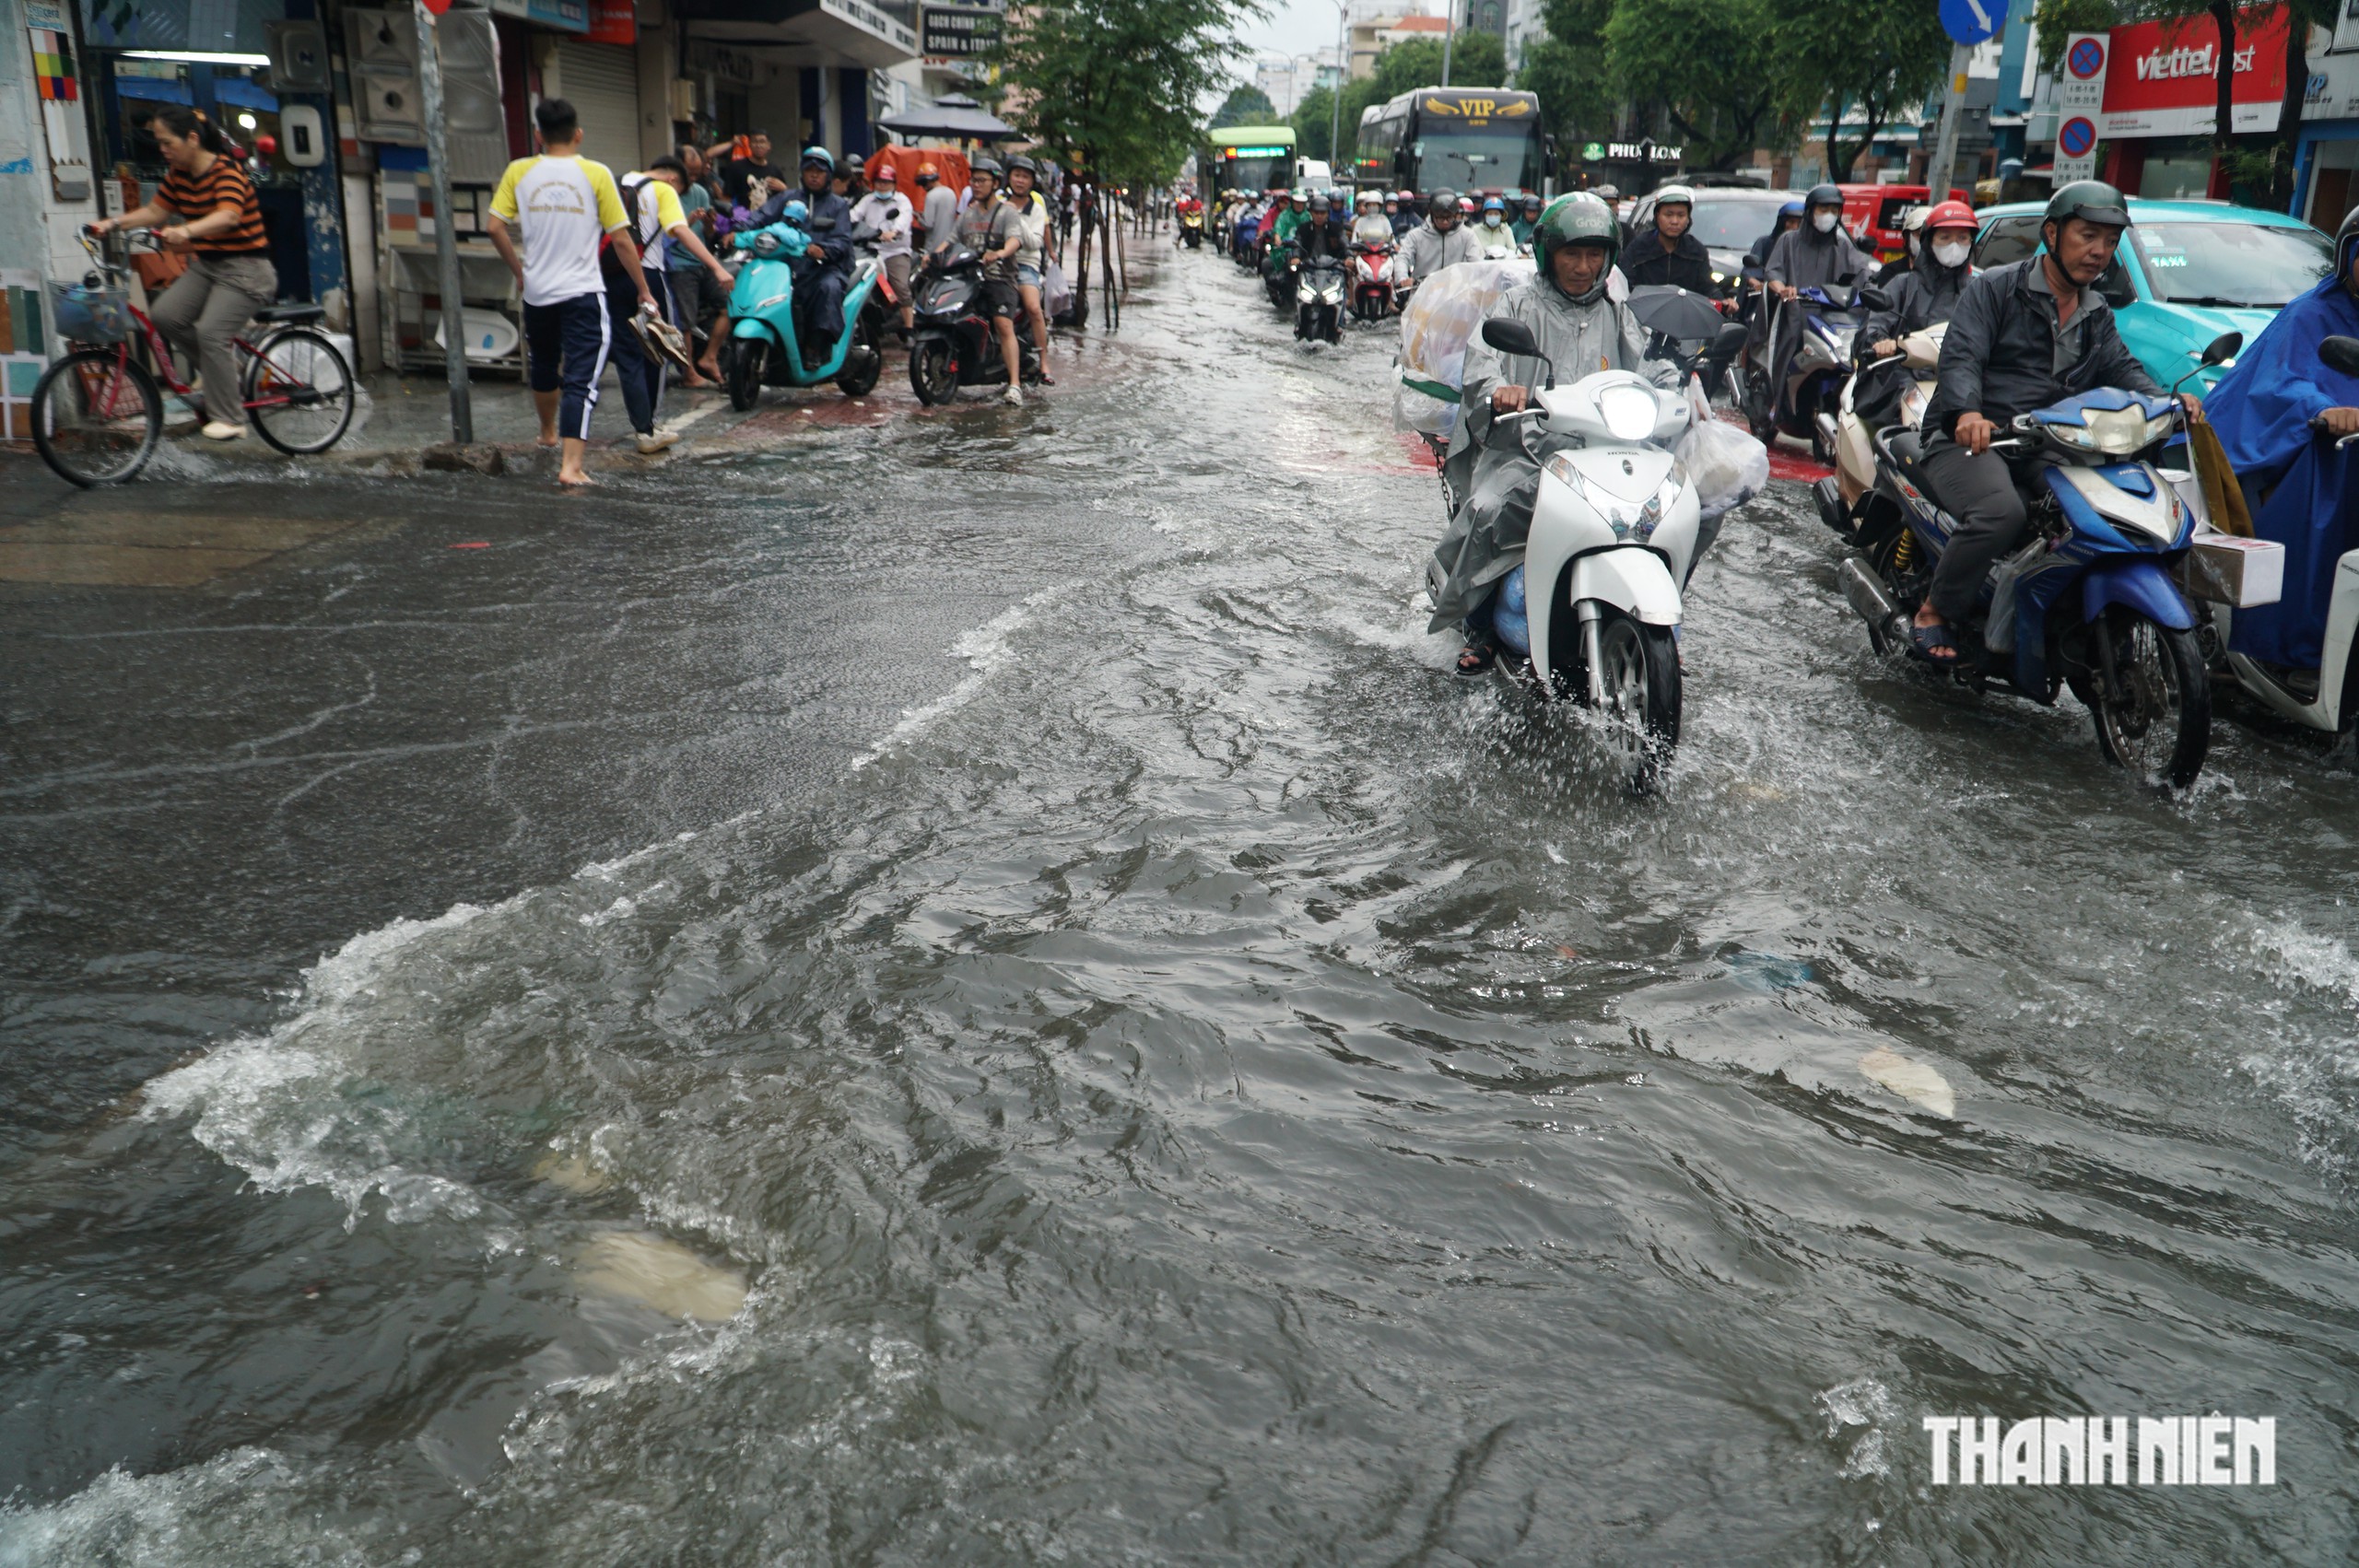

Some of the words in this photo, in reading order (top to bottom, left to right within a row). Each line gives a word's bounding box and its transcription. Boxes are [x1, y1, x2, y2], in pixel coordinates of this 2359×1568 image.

[927, 35, 959, 51] SPAIN
[959, 39, 968, 52] &
[2137, 42, 2213, 81] viettel
[1459, 99, 1496, 117] VIP
[1576, 217, 1605, 228] Grab
